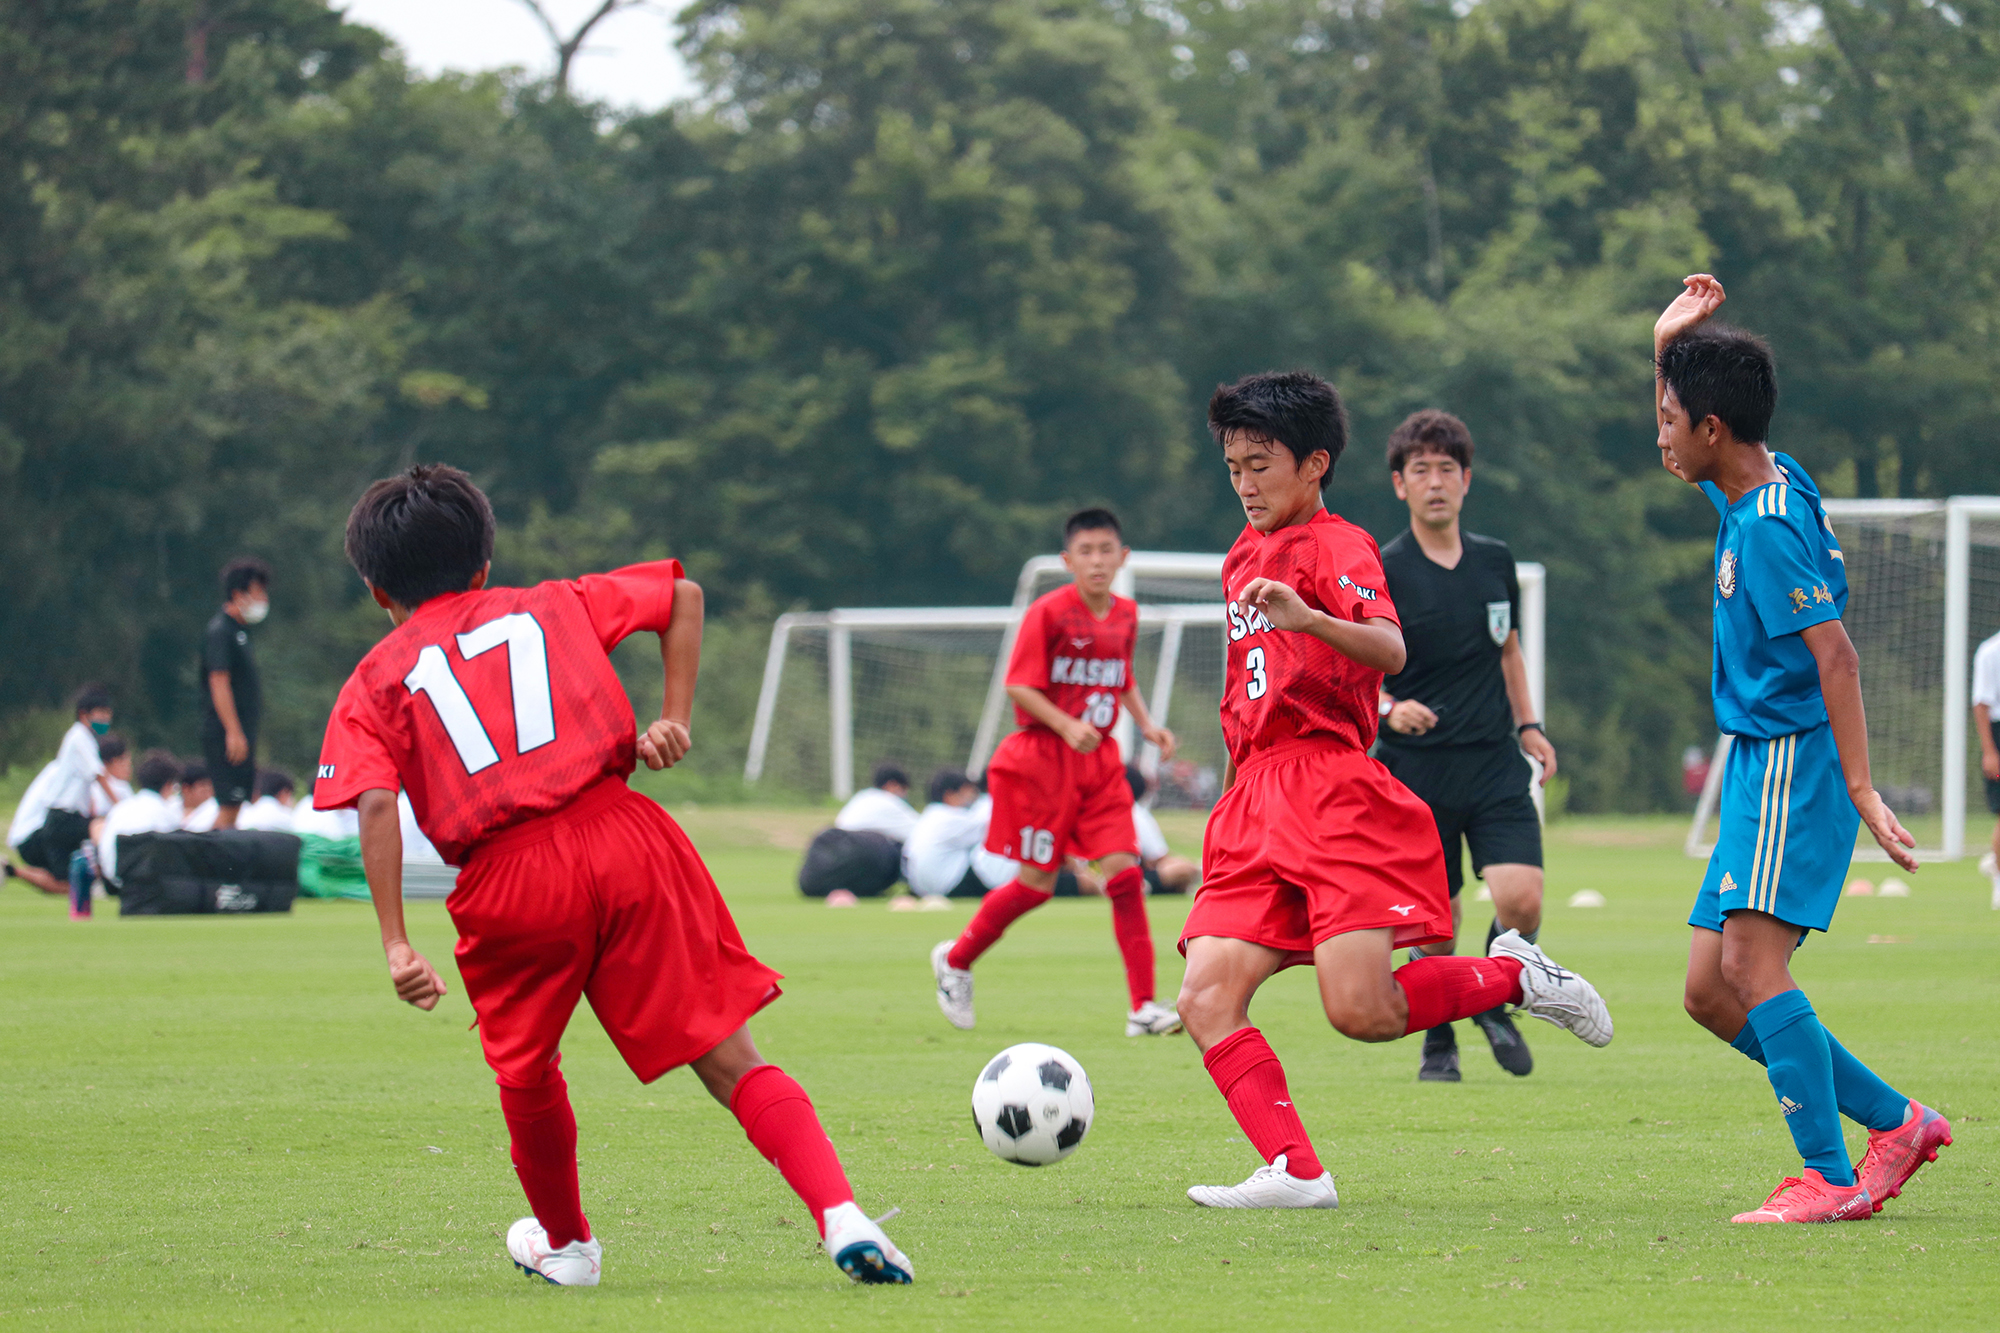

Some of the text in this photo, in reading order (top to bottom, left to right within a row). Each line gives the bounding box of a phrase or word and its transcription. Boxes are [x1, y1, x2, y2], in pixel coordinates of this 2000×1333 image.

[1246, 646, 1267, 700] 3
[403, 611, 556, 776] 17
[1080, 691, 1115, 728] 16
[1019, 825, 1055, 865] 16
[1824, 1193, 1864, 1224] ULTRA
